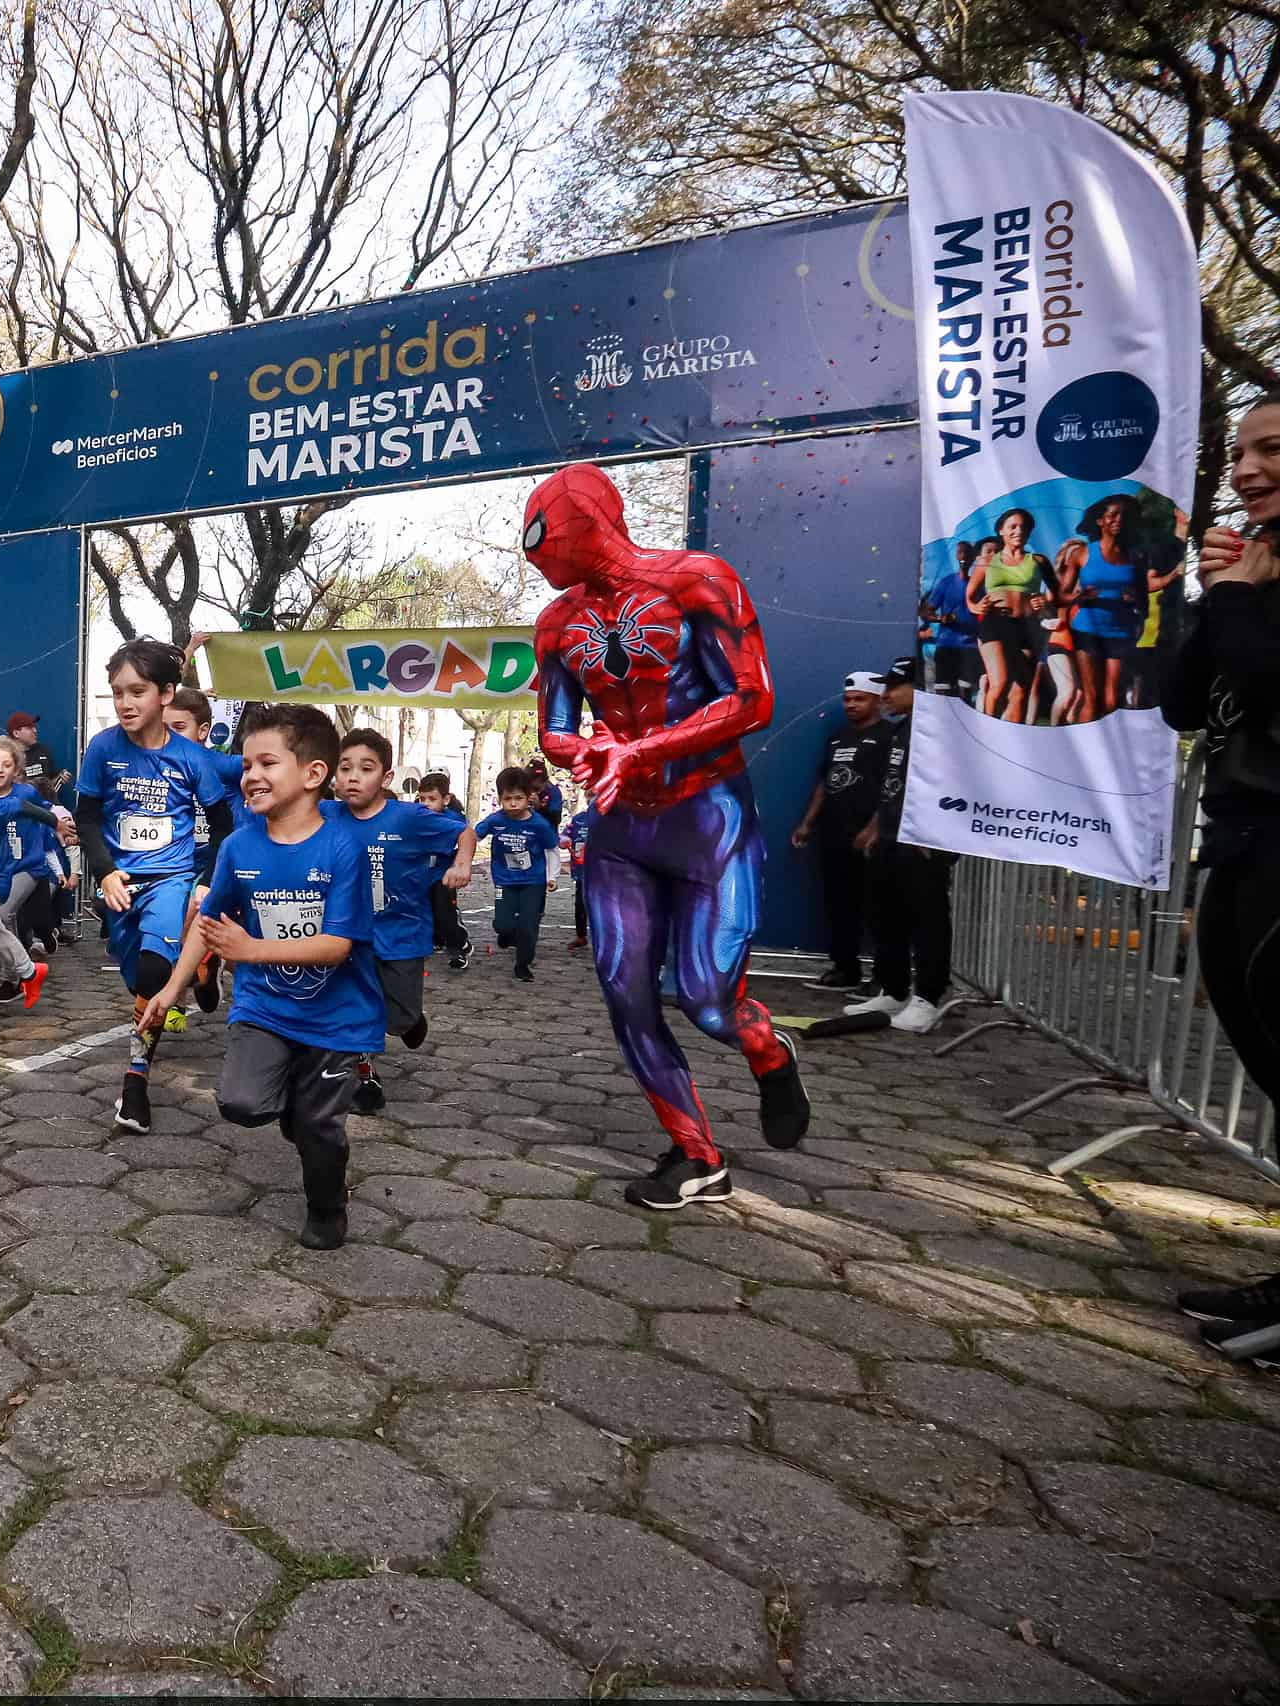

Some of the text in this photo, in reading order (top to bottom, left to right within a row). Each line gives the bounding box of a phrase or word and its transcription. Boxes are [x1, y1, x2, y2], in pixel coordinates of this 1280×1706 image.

[1042, 199, 1084, 348] corrida
[991, 206, 1031, 441] BEM-ESTAR
[642, 335, 730, 362] GRUPO
[933, 216, 984, 467] MARISTA
[248, 319, 487, 401] corrida
[641, 349, 758, 381] MARISTA
[248, 376, 484, 443] BEM-ESTAR
[76, 421, 183, 452] MercerMarsh
[247, 416, 481, 486] MARISTA
[264, 641, 538, 692] LARGAD
[123, 791, 167, 804] MARISTA
[972, 801, 1112, 834] MercerMarsh
[129, 827, 159, 841] 340
[370, 870, 384, 879] 23
[253, 888, 321, 901] corrida kids
[276, 921, 318, 940] 360
